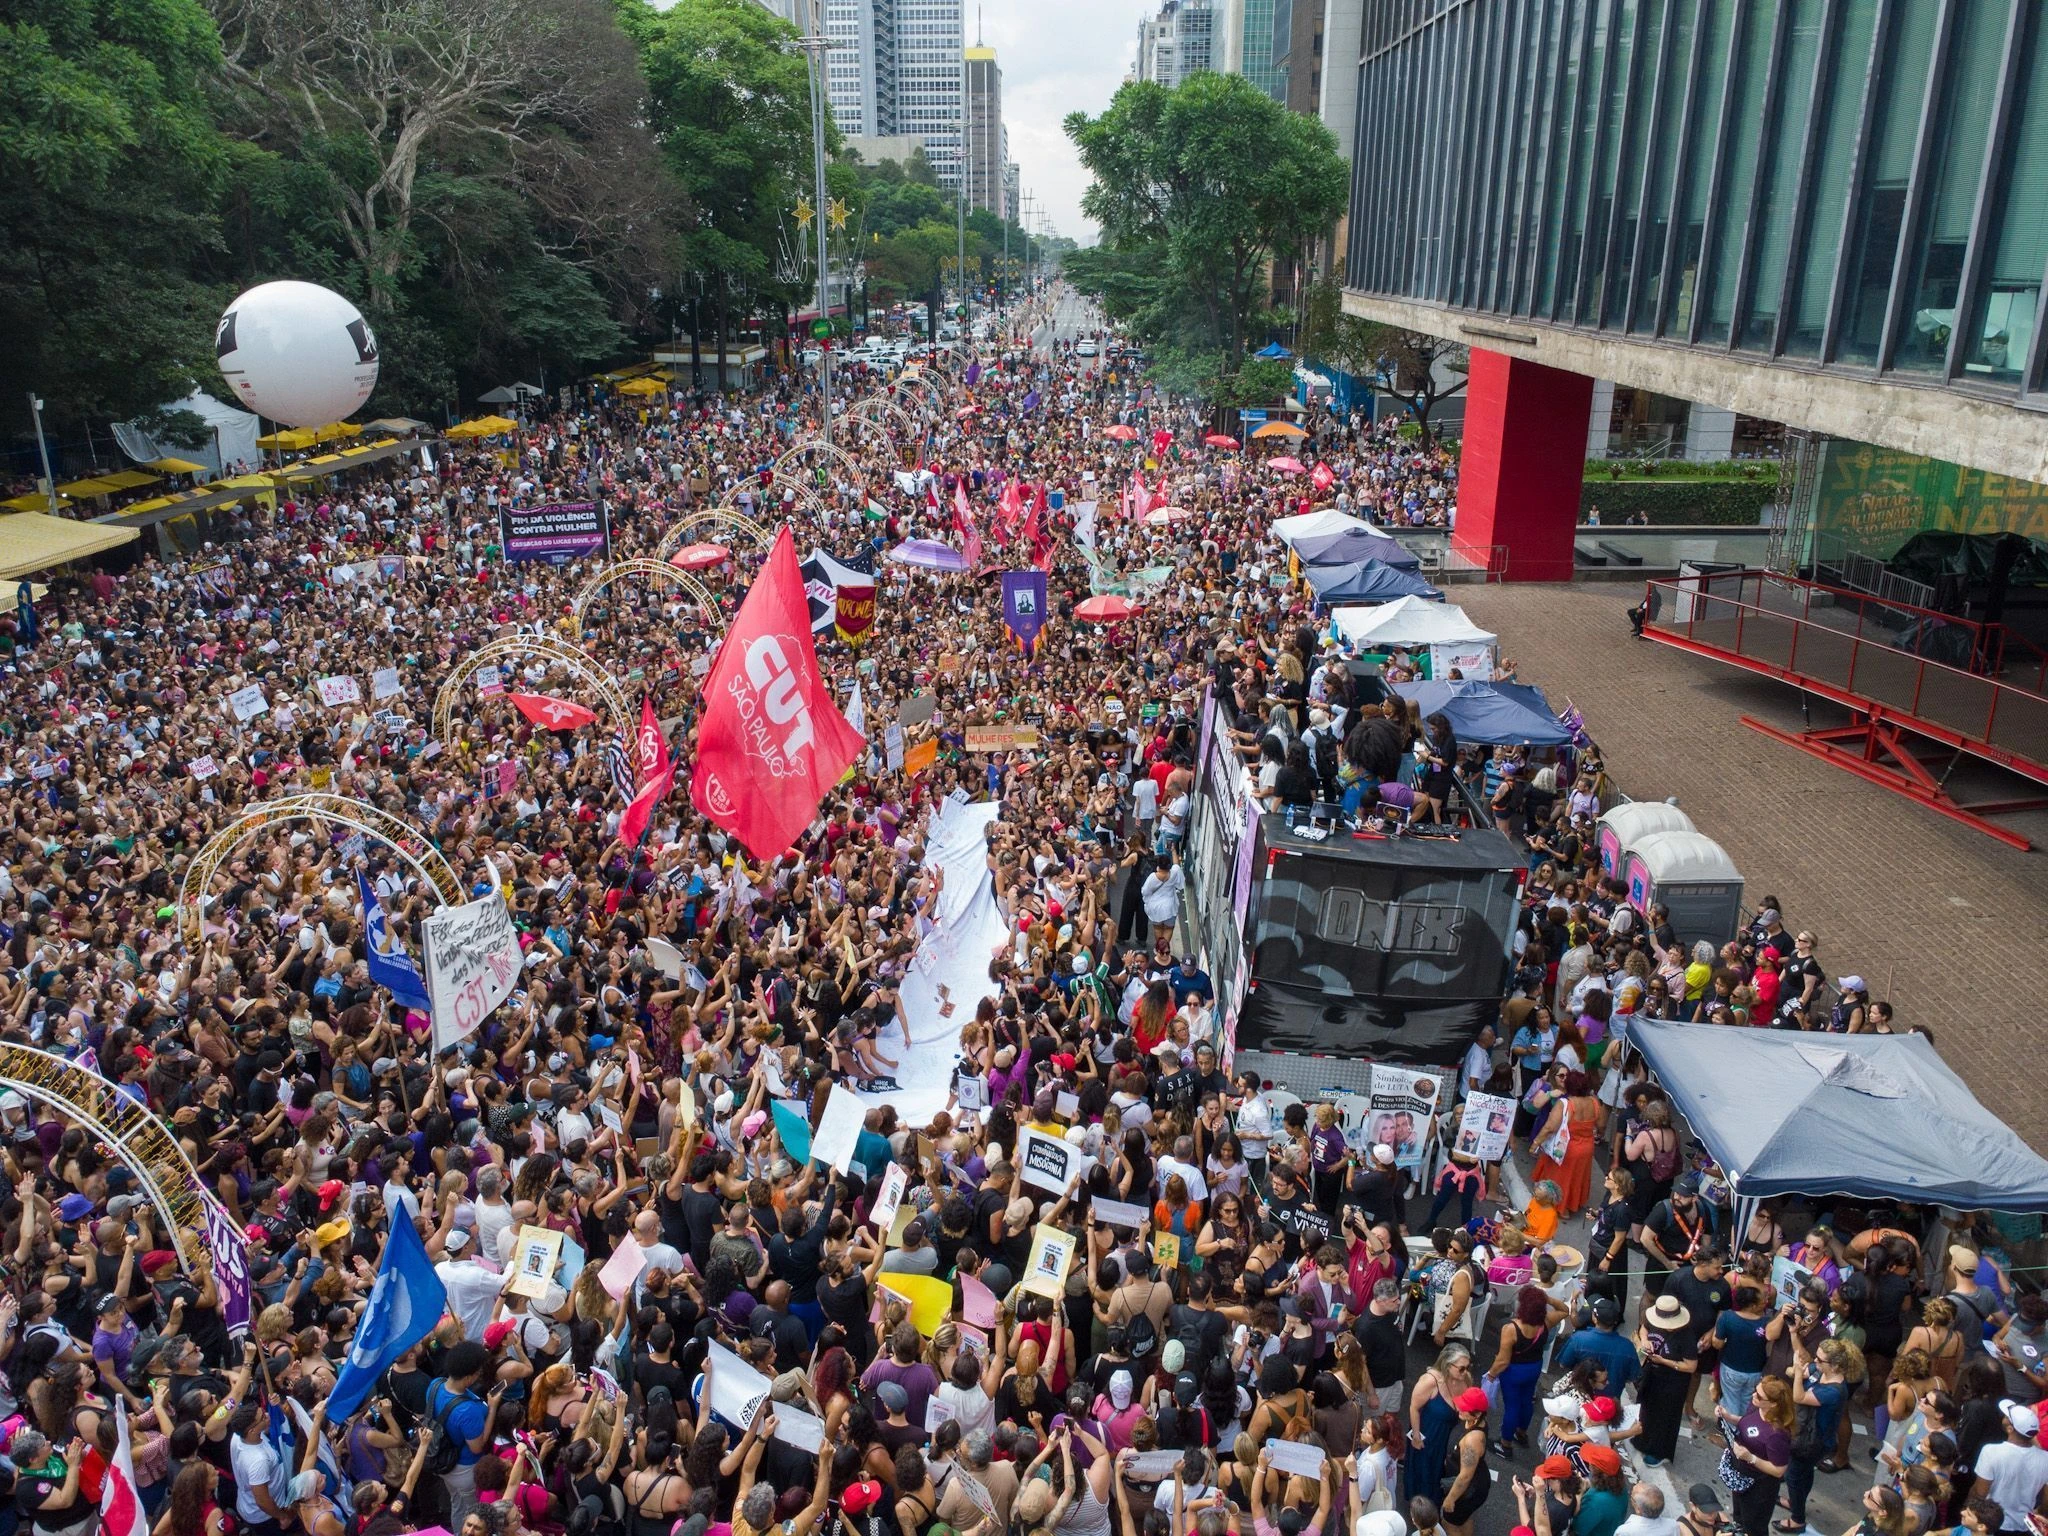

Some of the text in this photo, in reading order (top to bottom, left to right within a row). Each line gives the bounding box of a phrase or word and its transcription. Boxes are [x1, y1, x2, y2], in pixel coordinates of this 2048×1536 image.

[511, 517, 529, 525] FIM
[545, 512, 597, 523] VIOLÊNCIA
[513, 522, 598, 535] CONTRA MULHER
[745, 634, 815, 760] CUT
[728, 674, 785, 777] SÃO PAULO
[969, 734, 1014, 744] MULHERES
[1316, 886, 1467, 955] ONIX
[451, 966, 469, 984] das
[454, 976, 488, 1030] CST
[1167, 1073, 1192, 1091] SEX
[1029, 1154, 1063, 1178] MISOGINIA
[1295, 1209, 1328, 1226] MULHERES
